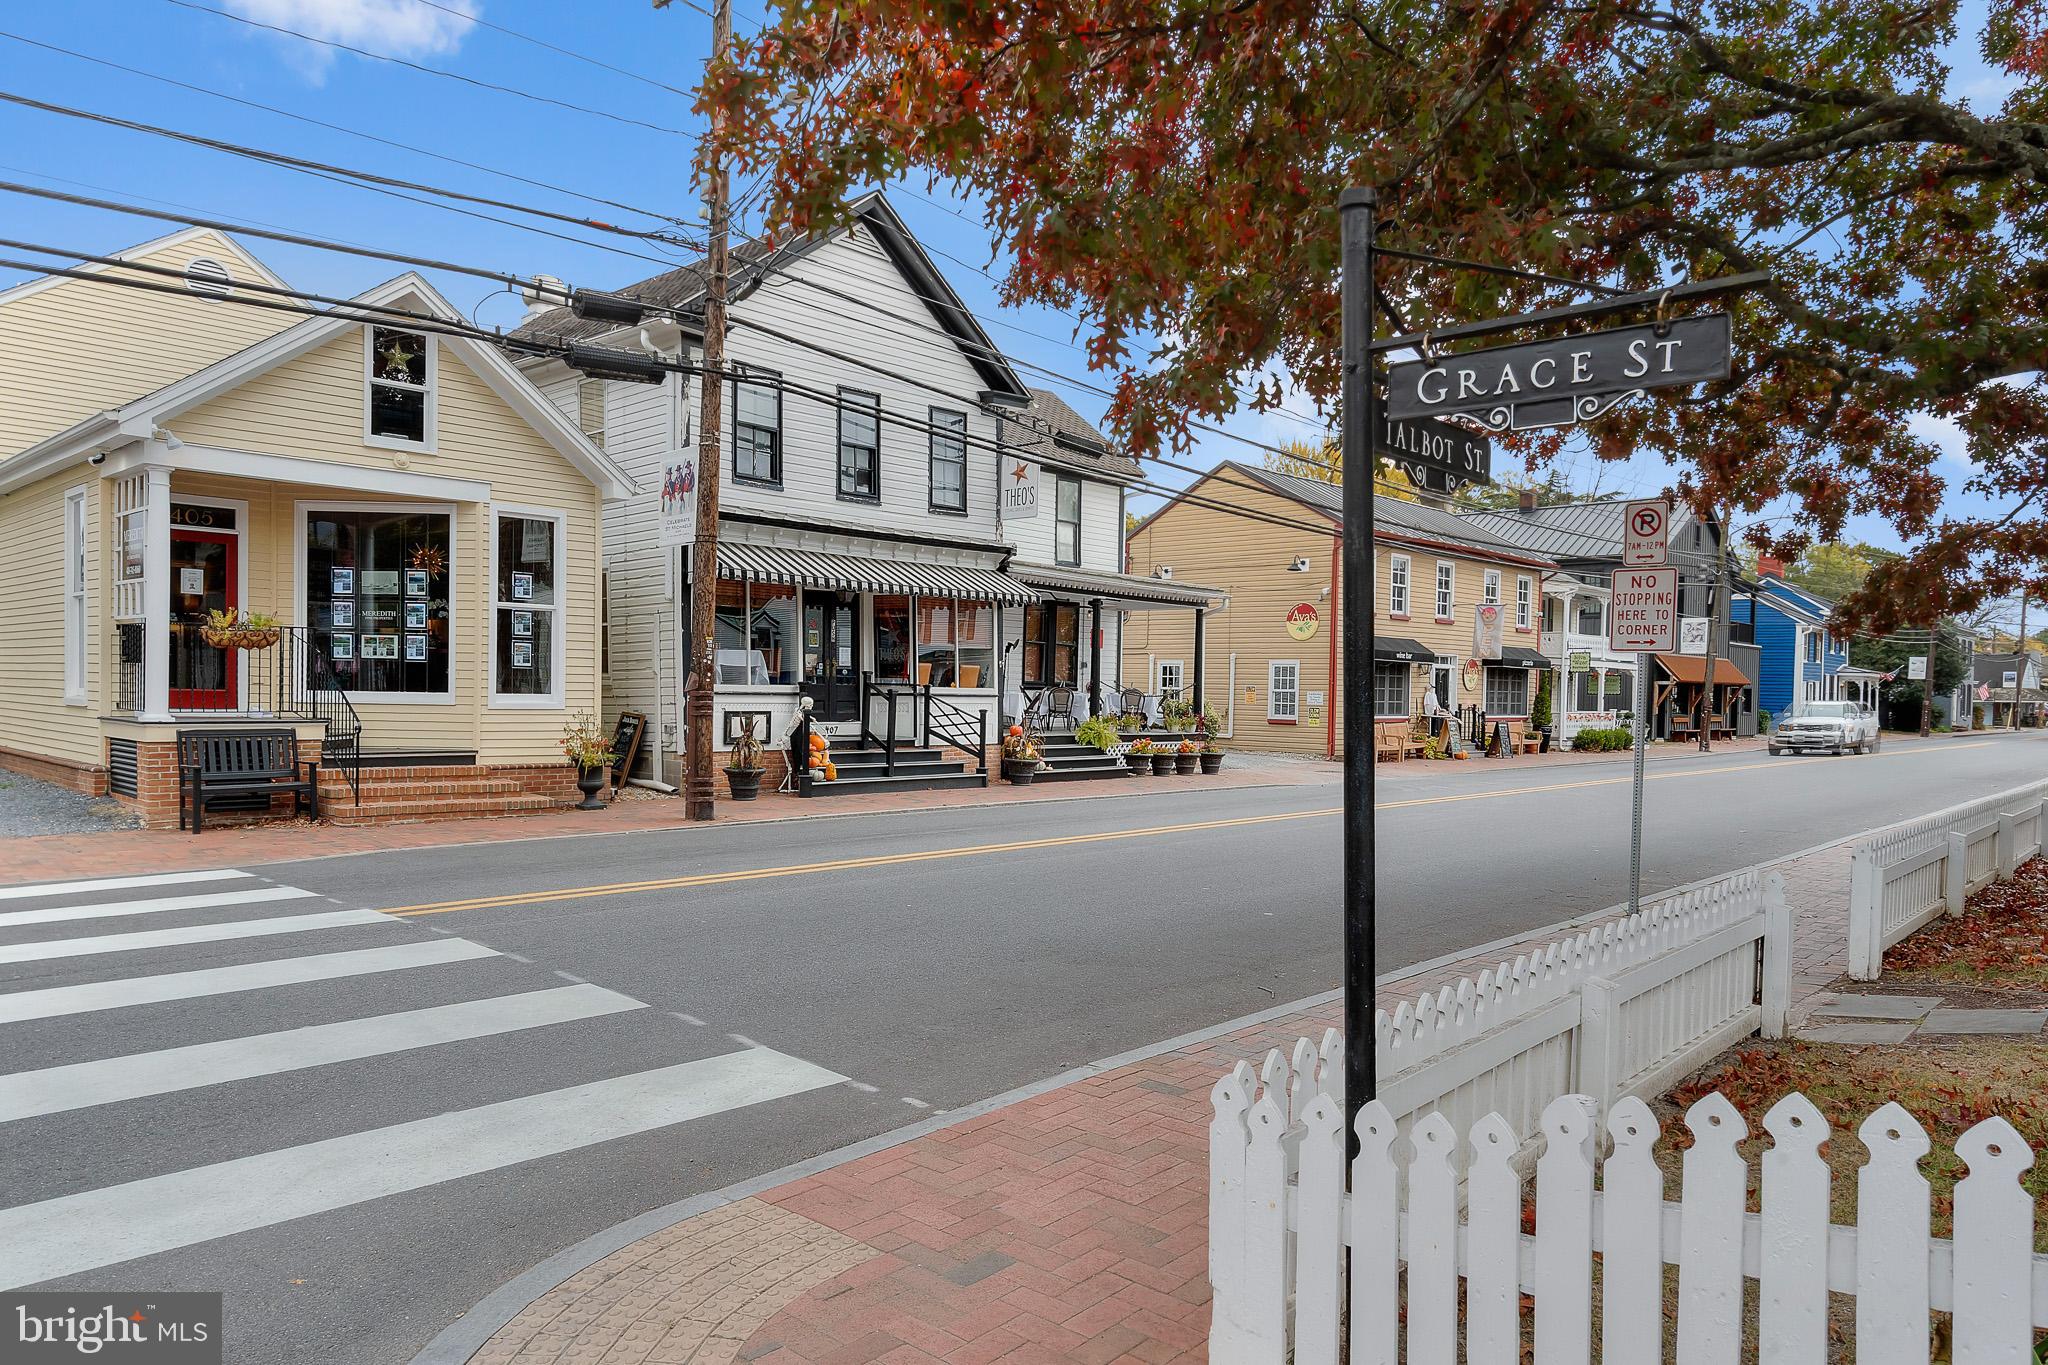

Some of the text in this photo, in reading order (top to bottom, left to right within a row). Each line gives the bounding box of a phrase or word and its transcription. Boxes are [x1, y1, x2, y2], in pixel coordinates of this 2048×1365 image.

[1417, 339, 1682, 404] GRACE ST
[1384, 413, 1485, 474] TALBOT ST.
[1005, 486, 1035, 507] THEO'S
[171, 508, 213, 526] 405
[666, 517, 690, 525] CELEBRATE
[671, 523, 692, 531] MICHAELS
[1631, 575, 1657, 589] NO
[1615, 592, 1672, 606] STOPPING
[1292, 610, 1316, 622] Ava's
[1617, 609, 1669, 621] HERE TO
[1618, 624, 1667, 635] CORNER
[825, 726, 839, 734] 407
